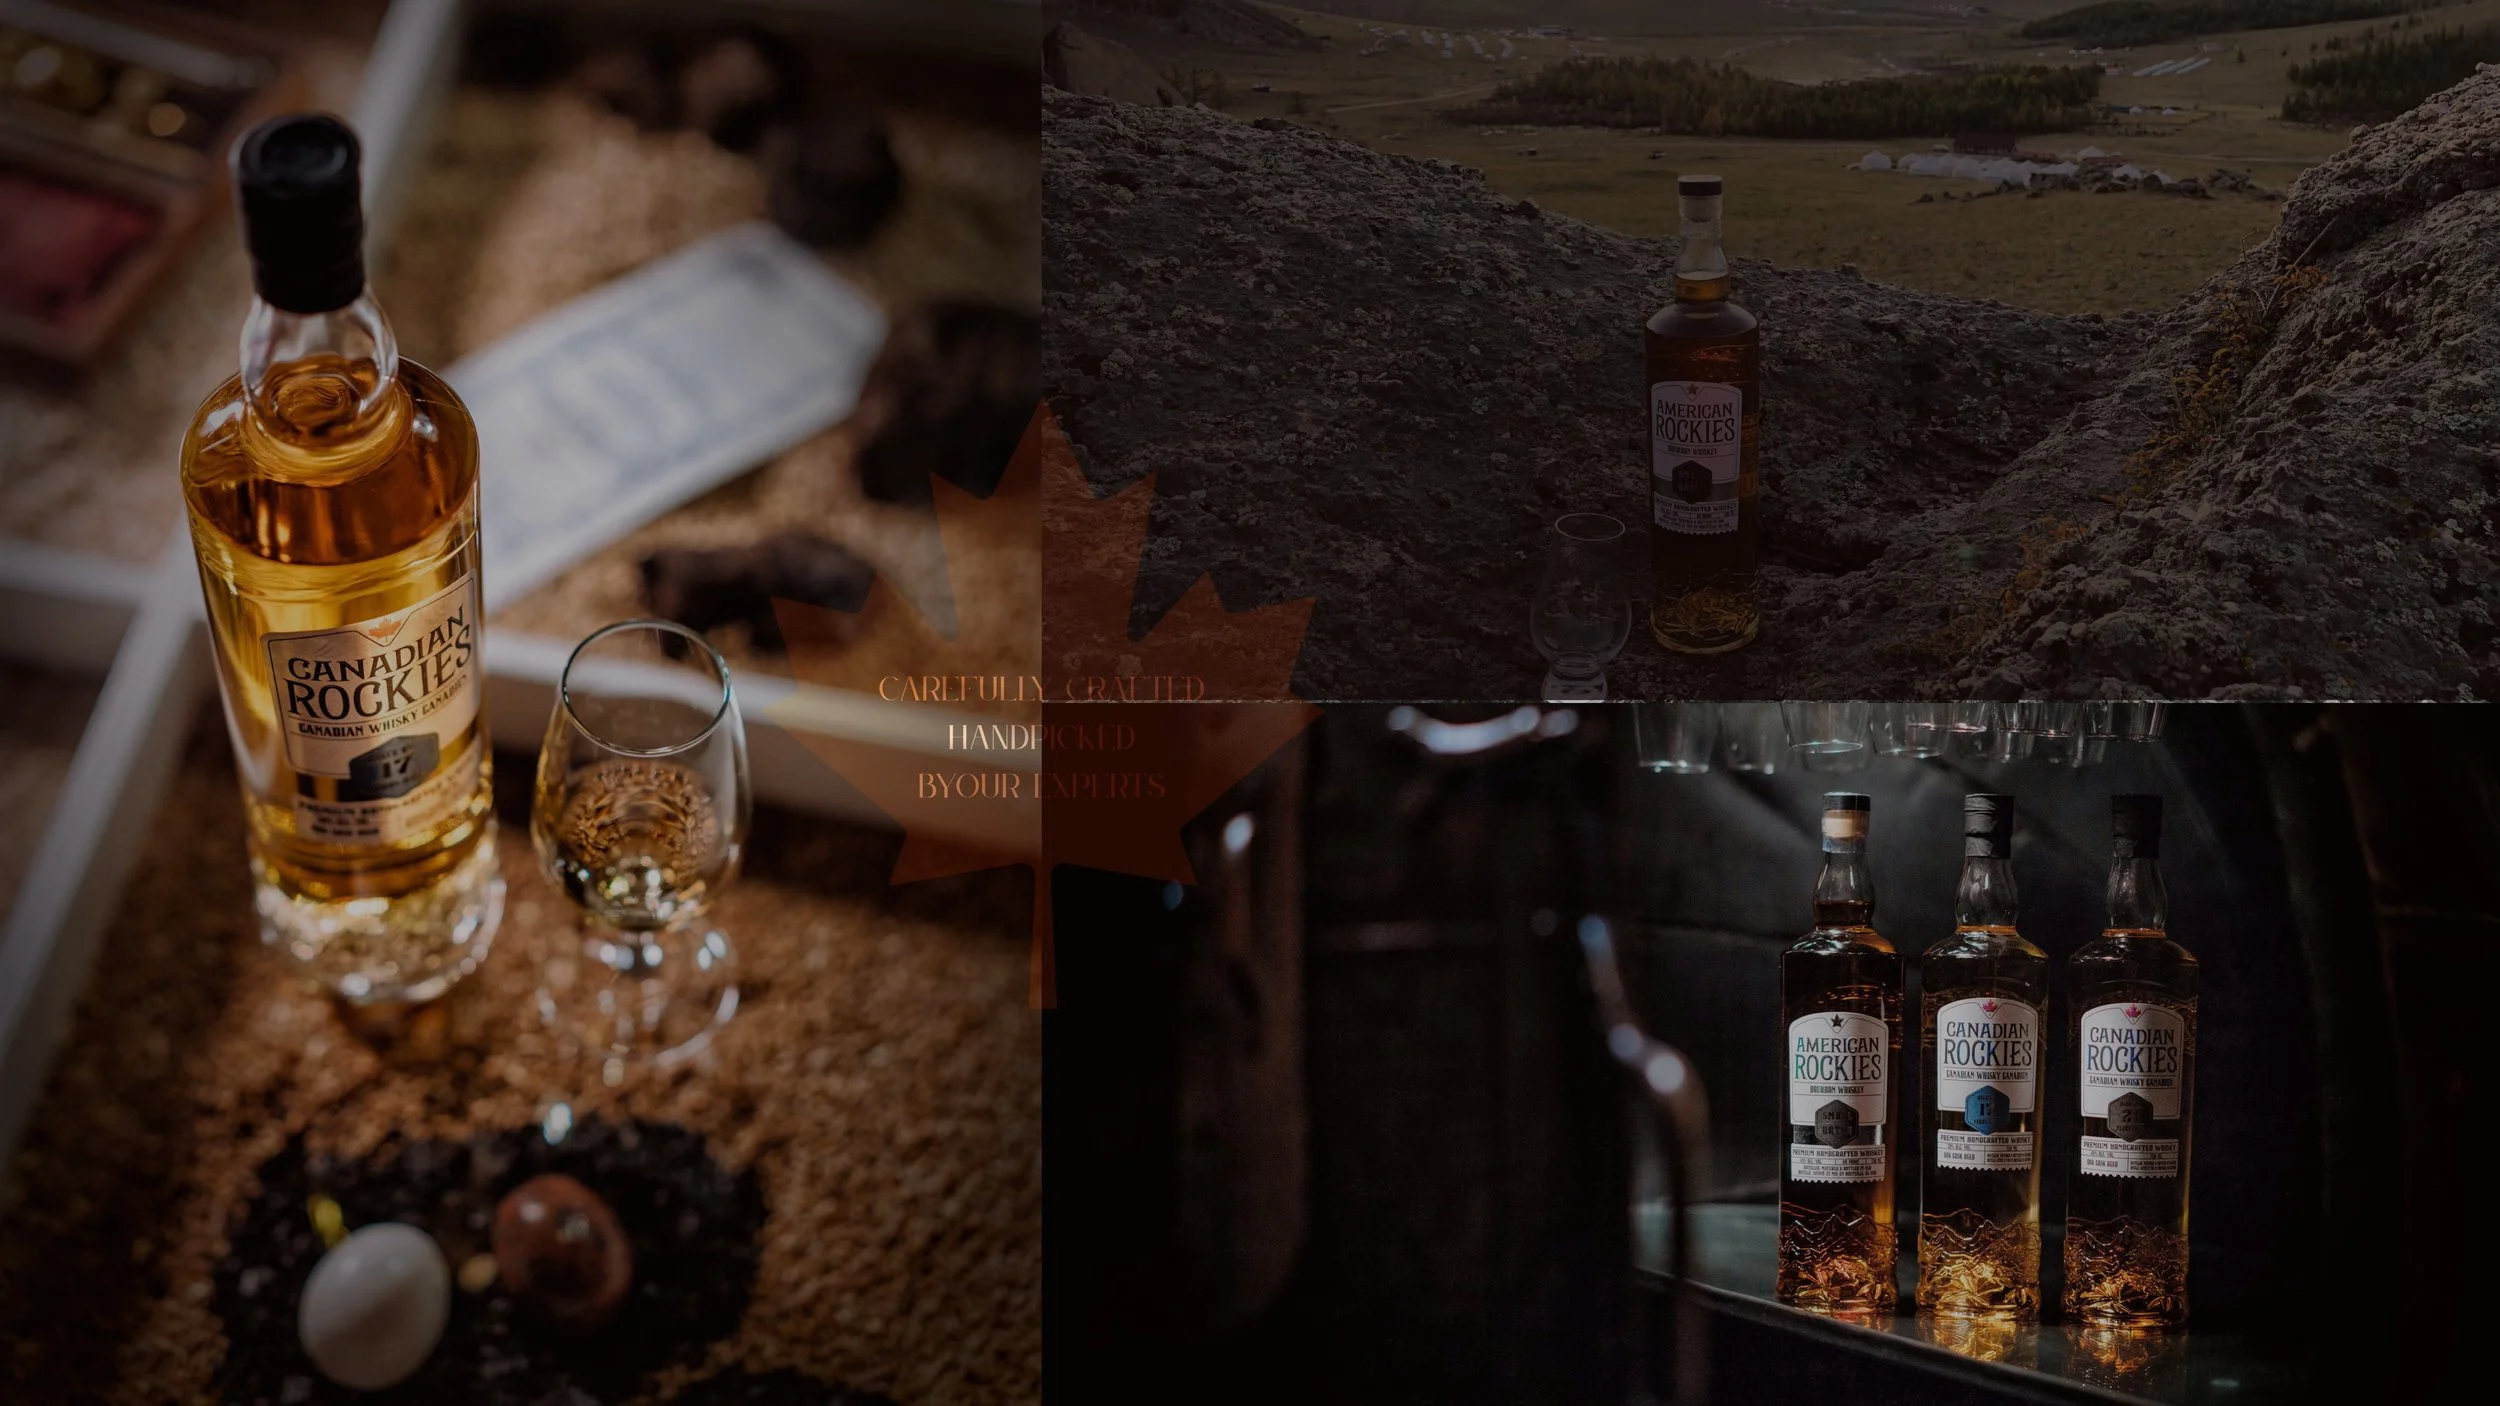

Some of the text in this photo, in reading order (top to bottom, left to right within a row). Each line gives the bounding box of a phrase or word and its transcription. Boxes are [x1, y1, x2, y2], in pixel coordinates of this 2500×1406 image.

[1657, 399, 1732, 419] AMERICAN
[1656, 414, 1735, 443] ROCKIES
[288, 605, 464, 682] CANADIAN
[284, 624, 470, 719] ROCKIES
[299, 723, 364, 736] CANADIAN
[370, 711, 418, 734] WHISKY
[382, 753, 413, 778] 17
[1946, 1021, 2029, 1038] CANADIAN
[2090, 1027, 2174, 1044] CANADIAN
[1796, 1037, 1879, 1053] AMERICAN
[1944, 1038, 2032, 1066] ROCKIES
[1794, 1054, 1882, 1080] ROCKIES
[2088, 1044, 2177, 1072] ROCKIES
[1946, 1070, 1974, 1079] CANADIAN
[1976, 1071, 2001, 1080] WHISKY
[2090, 1076, 2118, 1085] CANADIAN
[2119, 1077, 2144, 1086] WHISKY
[1838, 1085, 1864, 1094] WHISKEY
